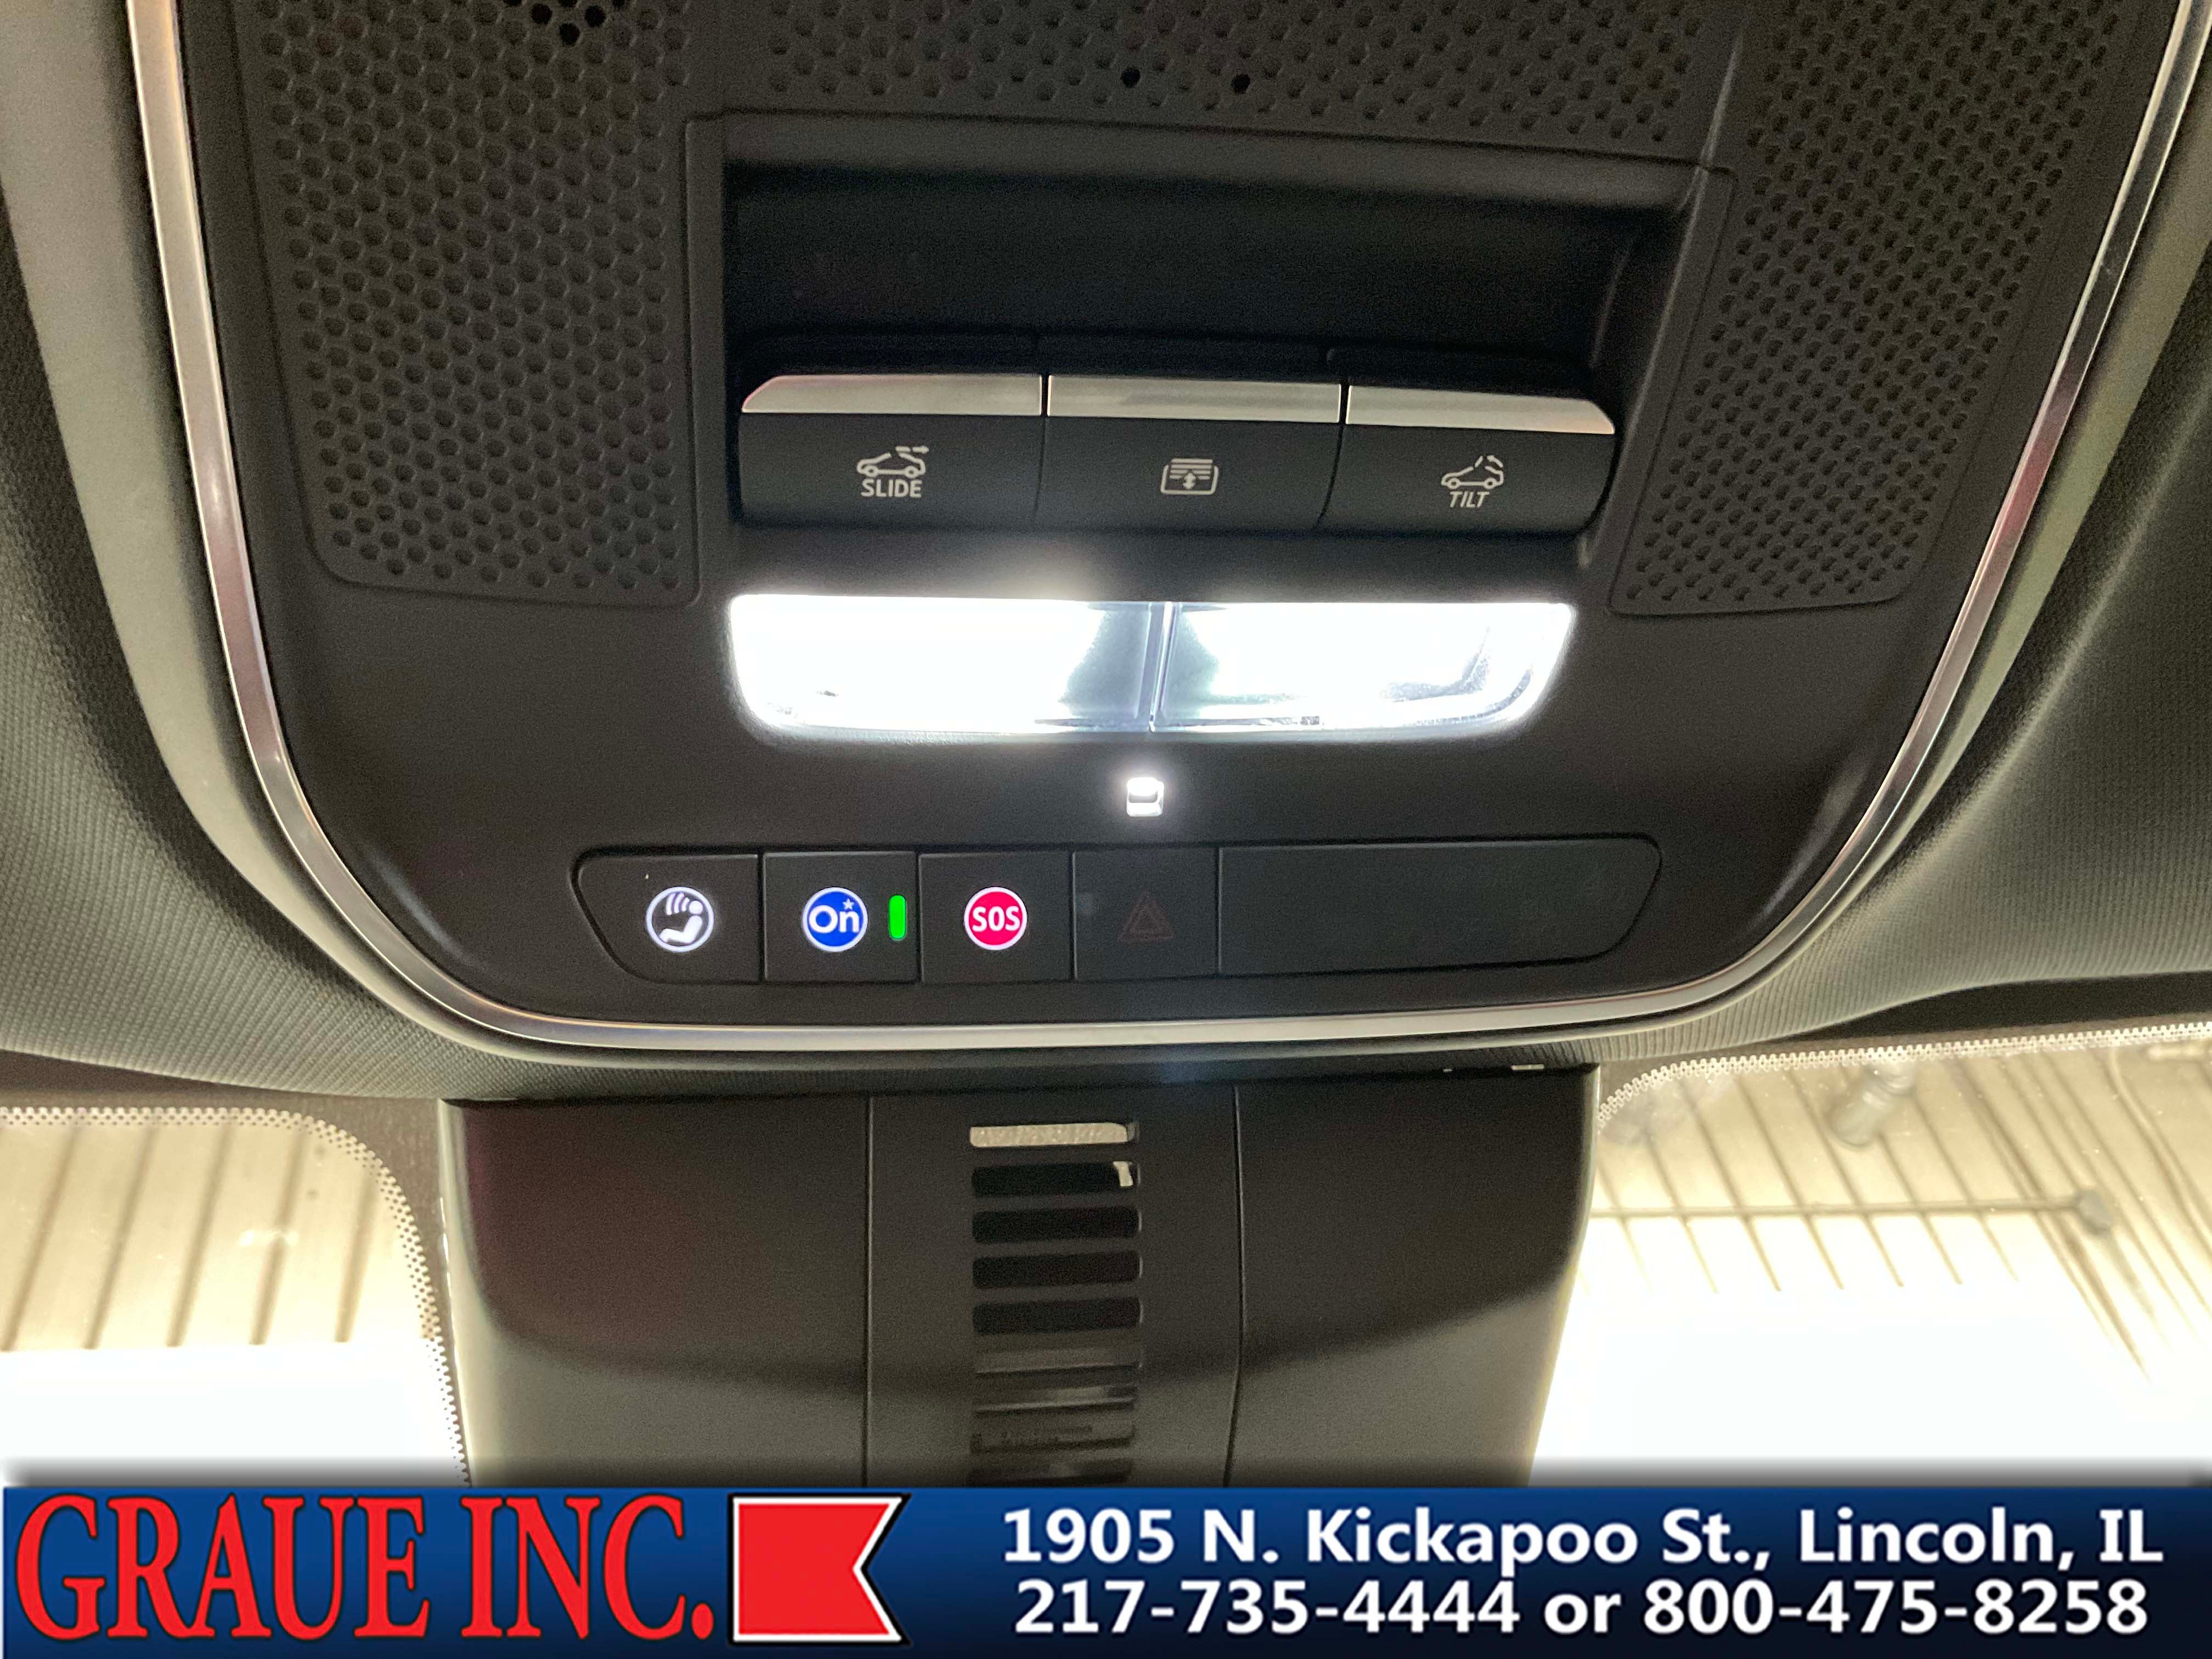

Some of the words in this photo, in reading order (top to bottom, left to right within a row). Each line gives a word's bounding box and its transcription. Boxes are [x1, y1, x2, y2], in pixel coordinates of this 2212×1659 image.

[860, 478, 923, 498] SLIDE
[1449, 491, 1490, 508] TILT
[972, 906, 1020, 932] SOS
